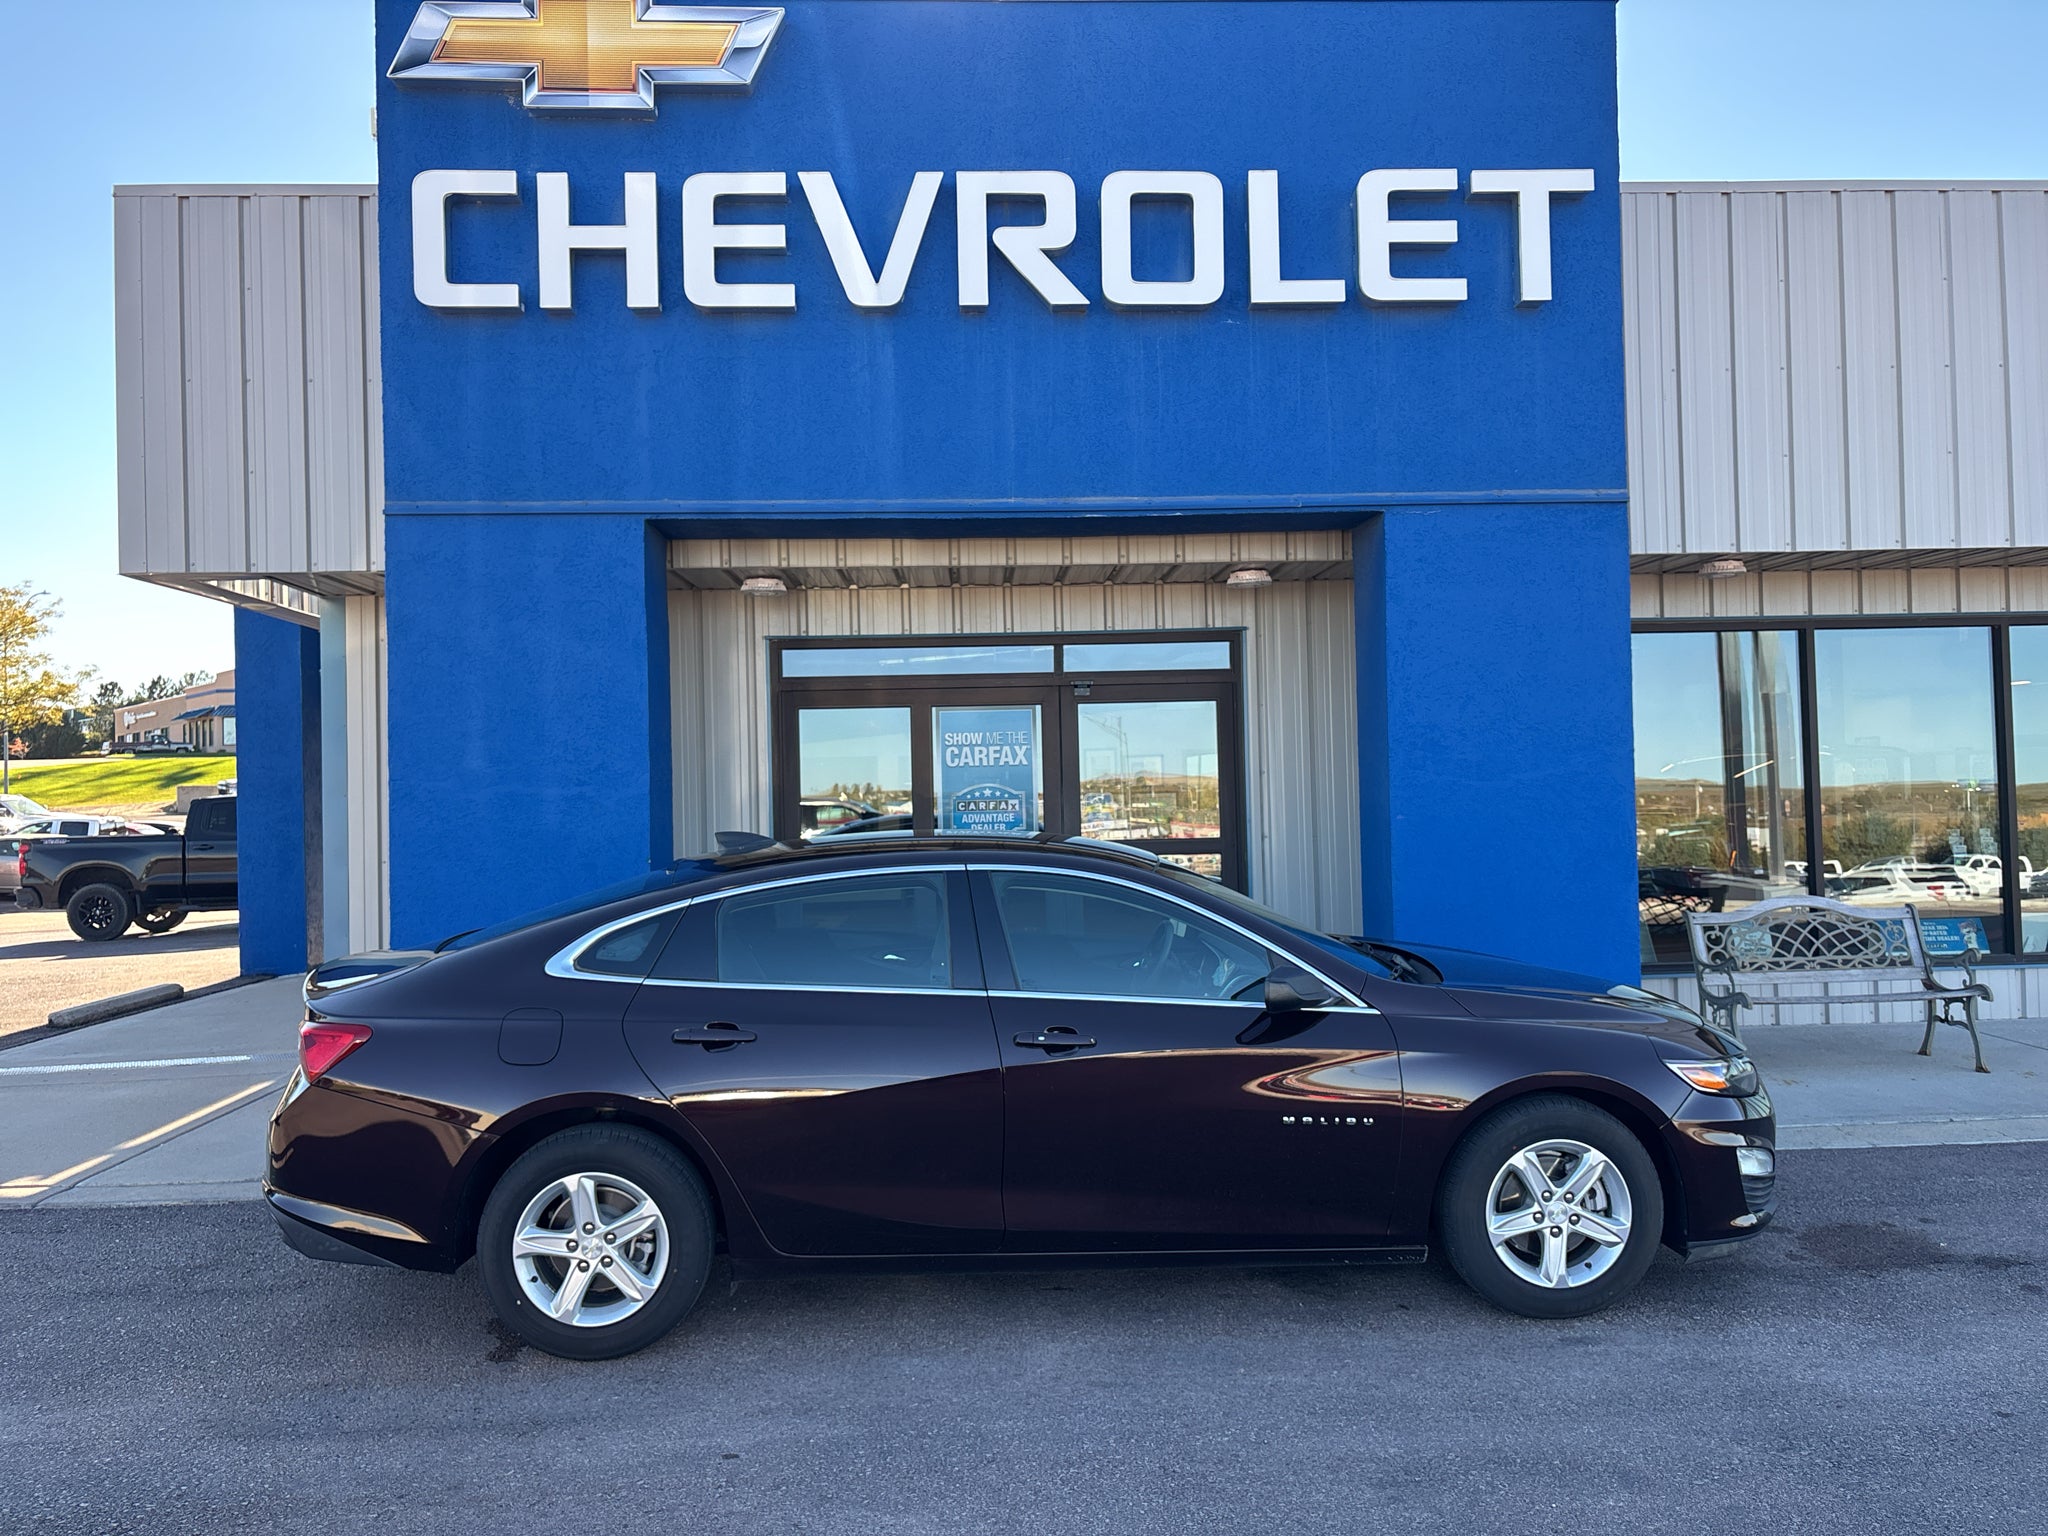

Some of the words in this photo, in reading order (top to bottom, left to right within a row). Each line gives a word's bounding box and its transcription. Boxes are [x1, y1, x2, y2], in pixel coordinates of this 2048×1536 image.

[411, 168, 1596, 310] CHEVROLET
[944, 732, 982, 746] SHOW
[986, 731, 1004, 744] ME
[1006, 731, 1028, 744] THE
[945, 745, 1029, 767] CARFAX
[957, 801, 1018, 811] CARFAX
[961, 813, 1015, 823] ADVANTAGE
[1282, 1116, 1374, 1125] MALIBU
